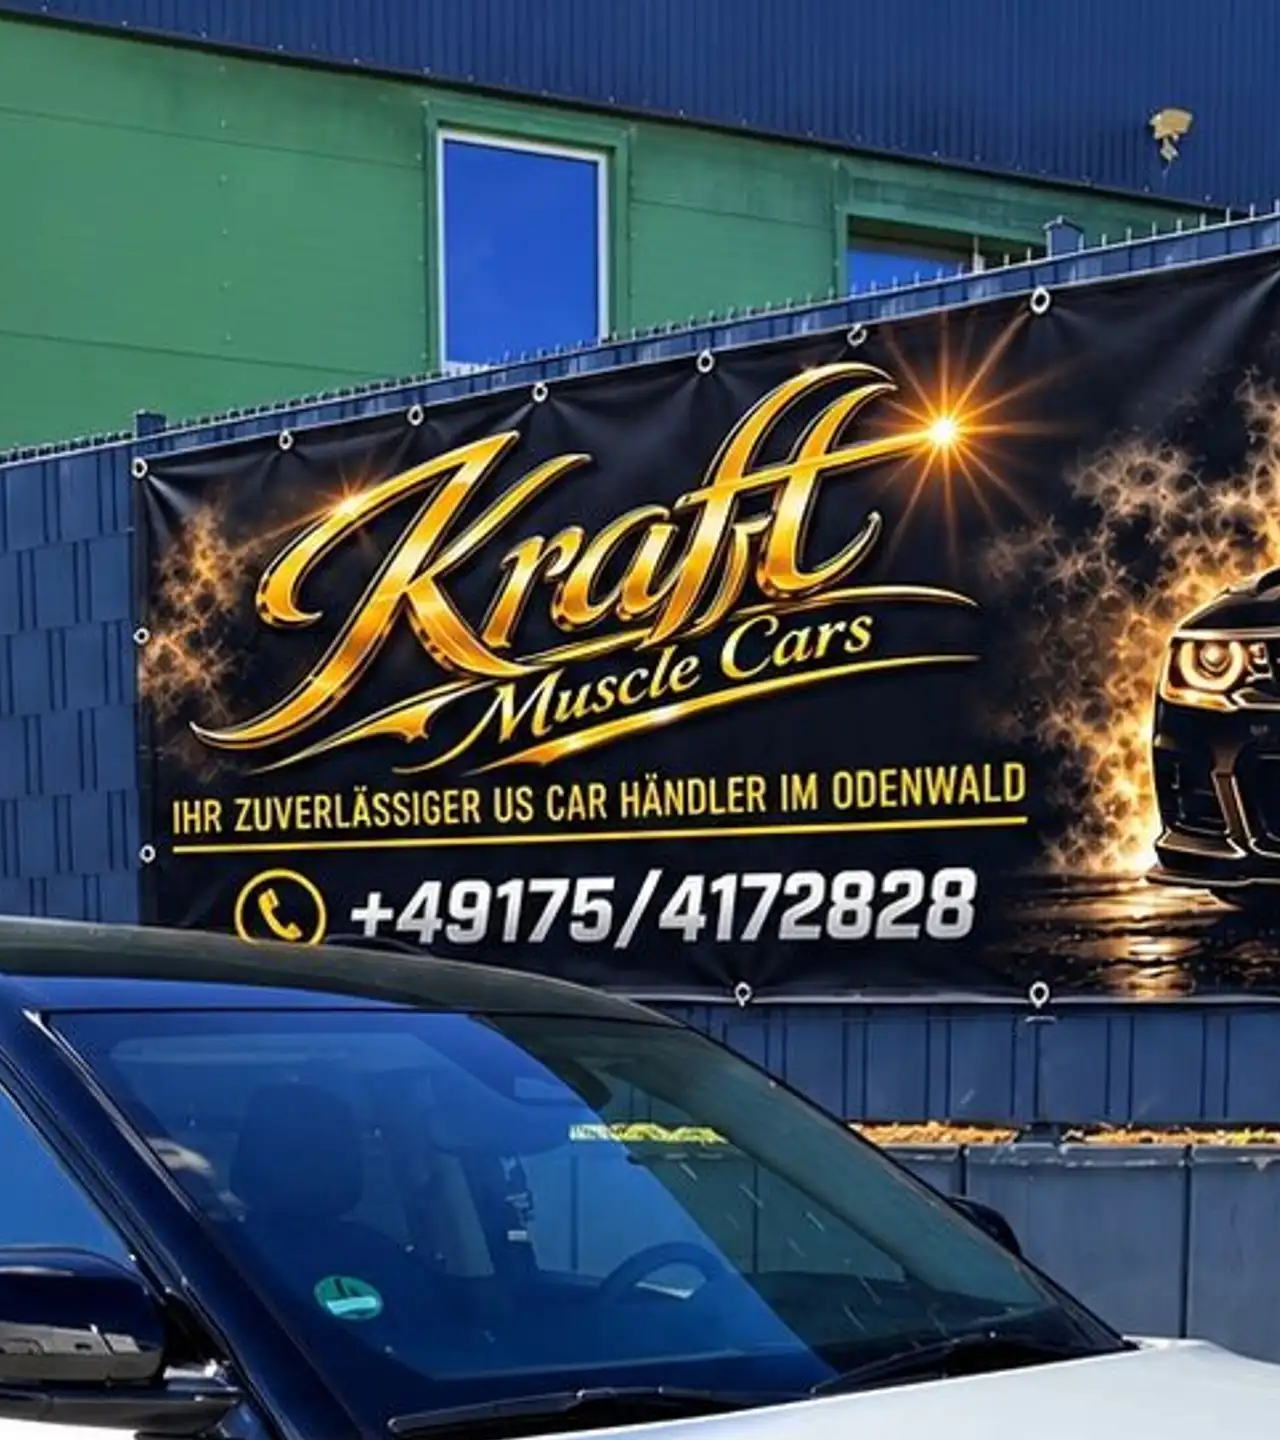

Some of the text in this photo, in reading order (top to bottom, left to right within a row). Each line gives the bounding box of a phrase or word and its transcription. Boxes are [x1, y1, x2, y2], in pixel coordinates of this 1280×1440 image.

[190, 363, 906, 750] Kraft
[426, 614, 873, 760] Muscle Cars
[172, 762, 1027, 834] IHR ZUVERLÄSSIGER US CAR HÄNDLER IM ODENWALD
[350, 866, 978, 949] +49175/4172828
